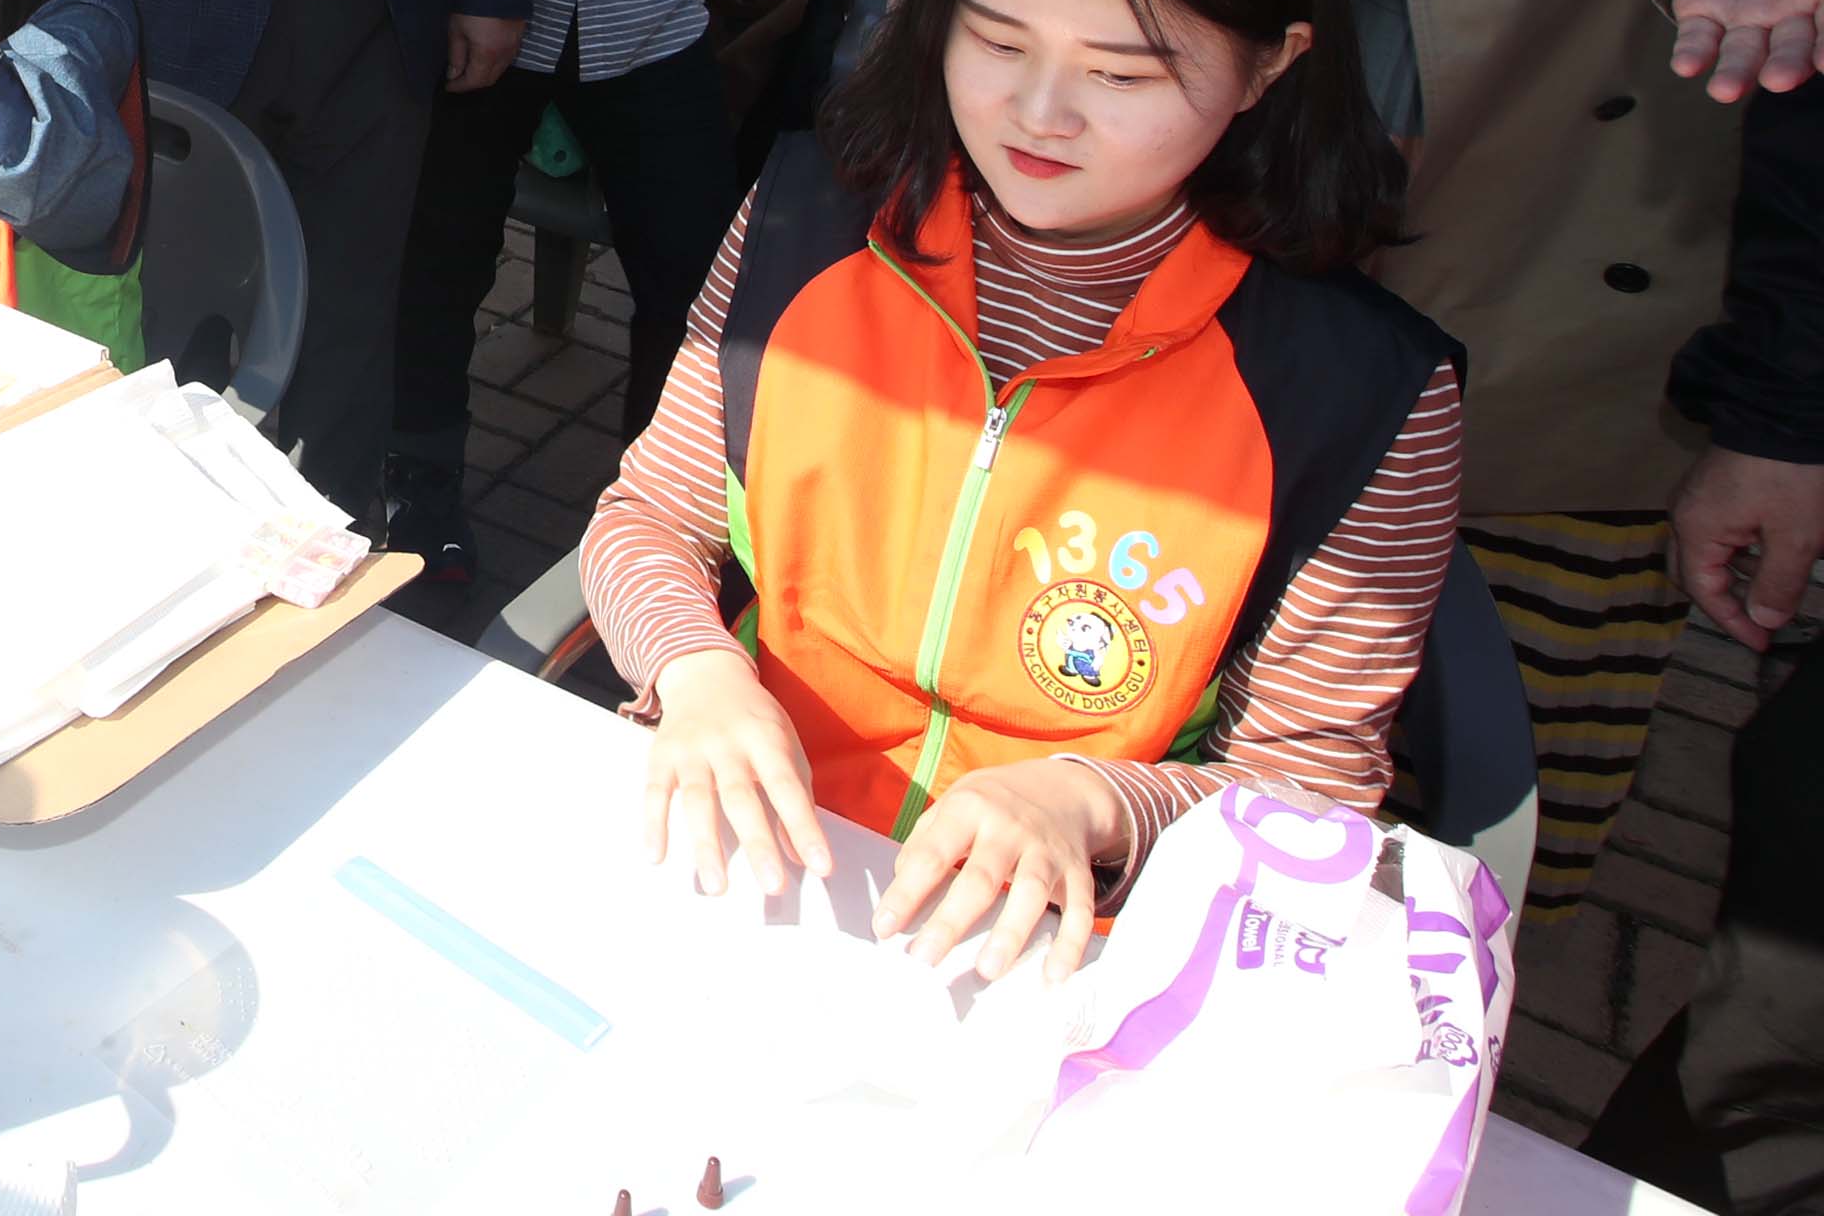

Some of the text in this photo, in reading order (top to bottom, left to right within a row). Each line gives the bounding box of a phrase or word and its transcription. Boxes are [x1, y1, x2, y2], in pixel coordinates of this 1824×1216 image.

[1013, 510, 1205, 625] 1365
[1026, 582, 1150, 655] 동구자원봉사센터
[1081, 669, 1147, 711] DONG-GU
[1241, 911, 1269, 953] Towel
